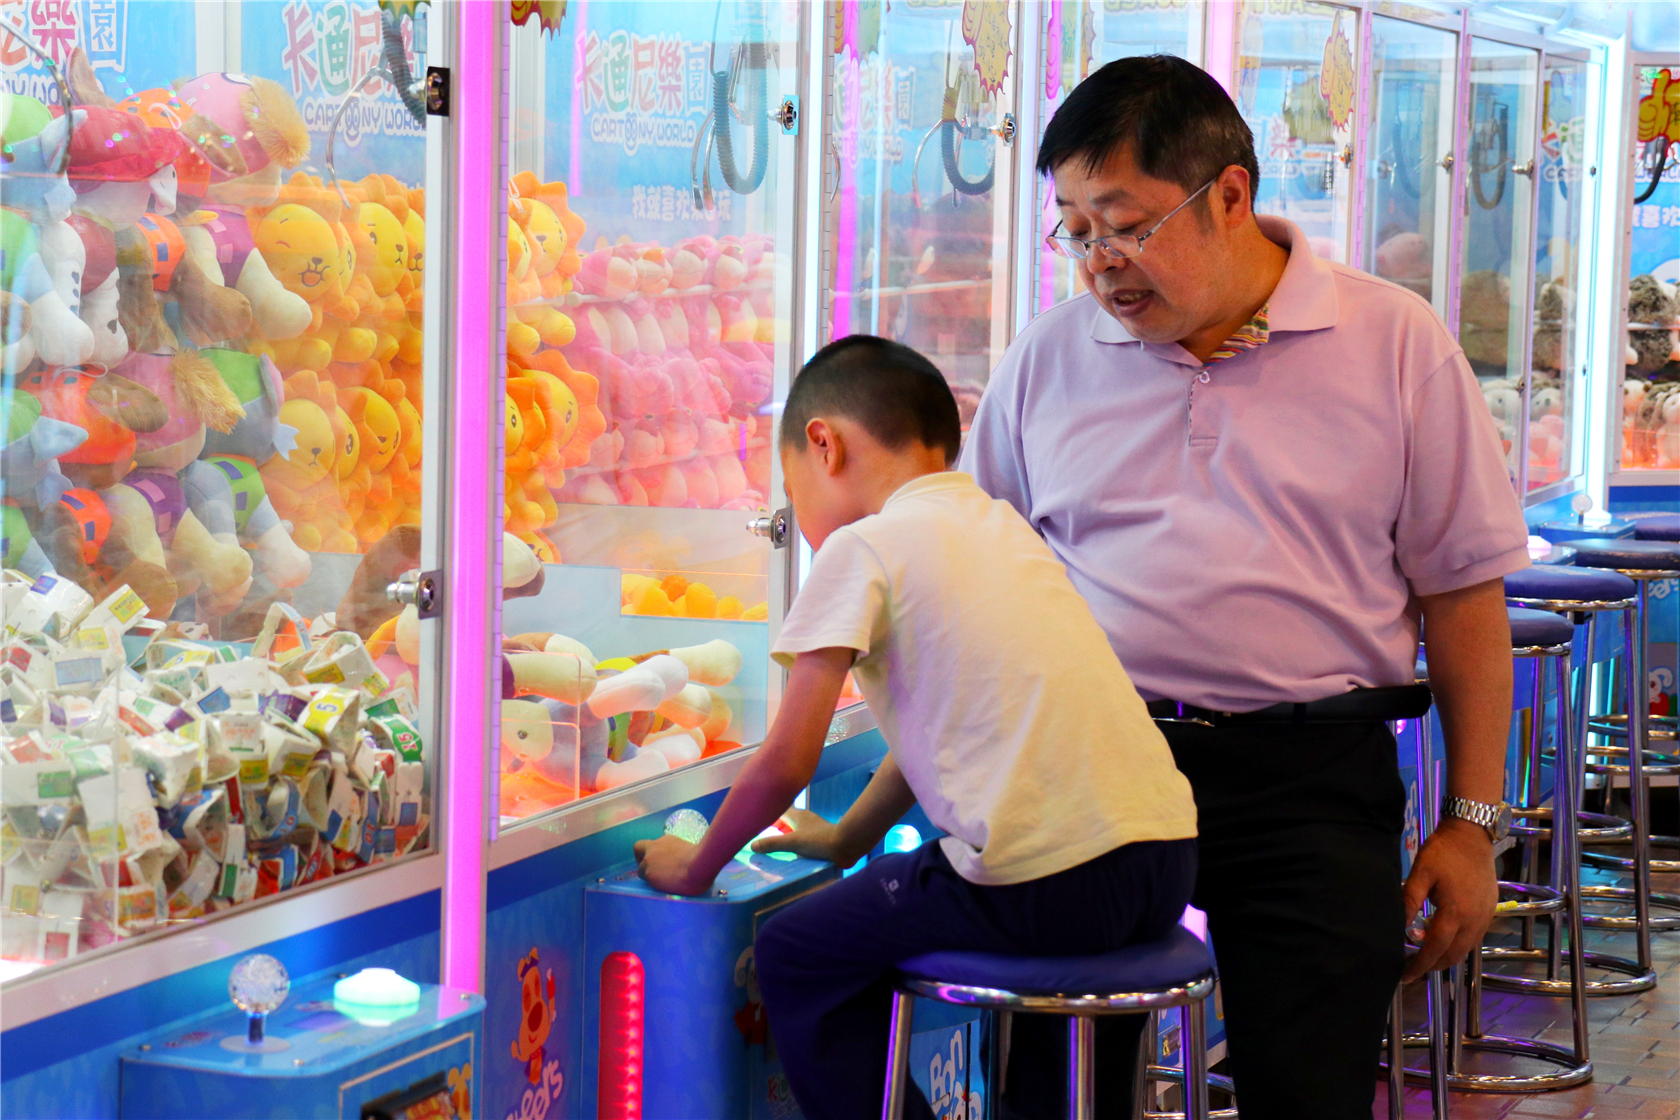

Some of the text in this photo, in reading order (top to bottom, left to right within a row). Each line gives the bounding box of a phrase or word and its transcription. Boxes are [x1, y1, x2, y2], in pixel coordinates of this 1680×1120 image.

[577, 32, 708, 113] 卡通尼樂園
[592, 112, 696, 150] CARTOONY WORLD
[316, 702, 338, 713] 5
